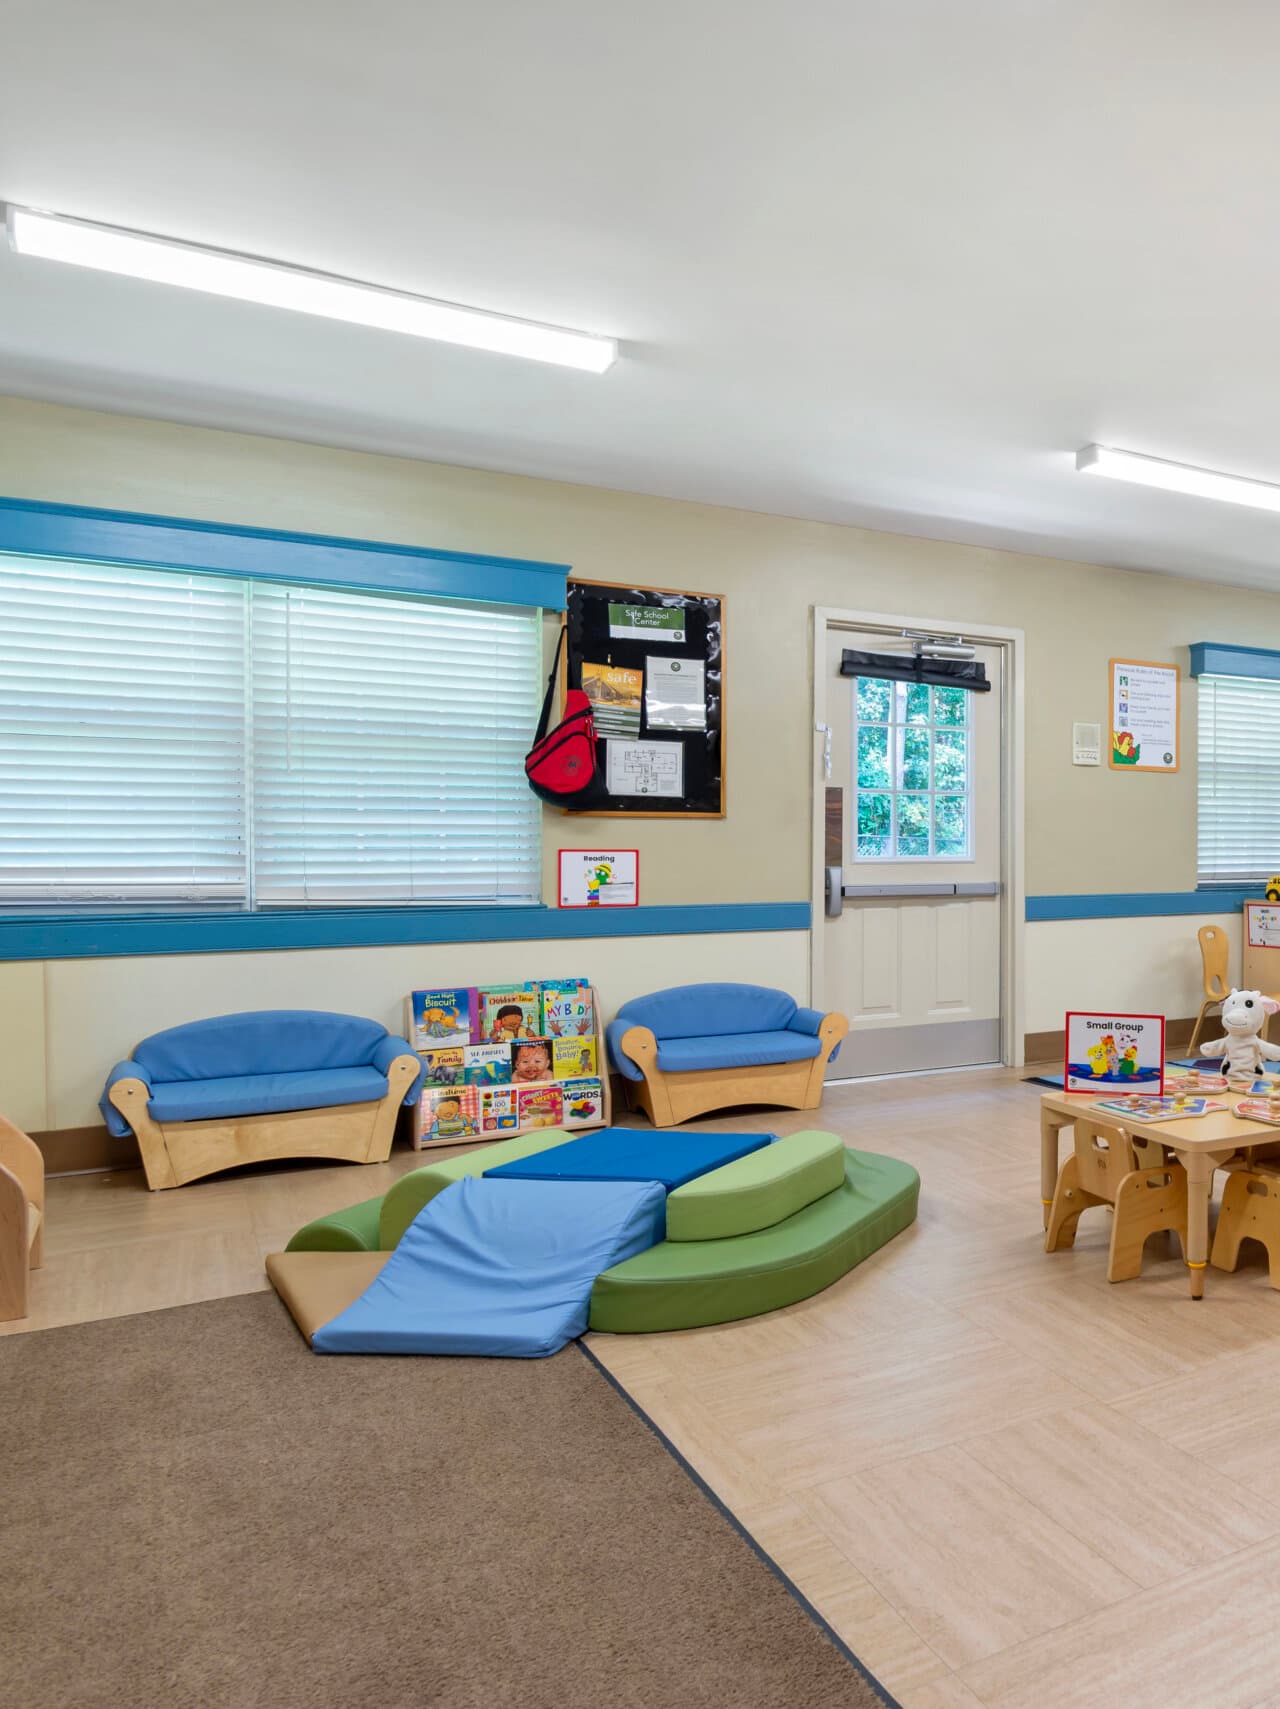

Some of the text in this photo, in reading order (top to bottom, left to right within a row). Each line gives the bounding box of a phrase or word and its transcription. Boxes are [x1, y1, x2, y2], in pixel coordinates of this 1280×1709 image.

[625, 609, 669, 619] Safe School
[634, 617, 661, 626] Center
[607, 671, 637, 684] safe
[583, 855, 615, 863] Reading
[425, 998, 457, 1008] Biscuit
[547, 1003, 591, 1020] MY BODY
[1086, 1021, 1144, 1033] Small Group
[563, 1090, 599, 1101] WORDS
